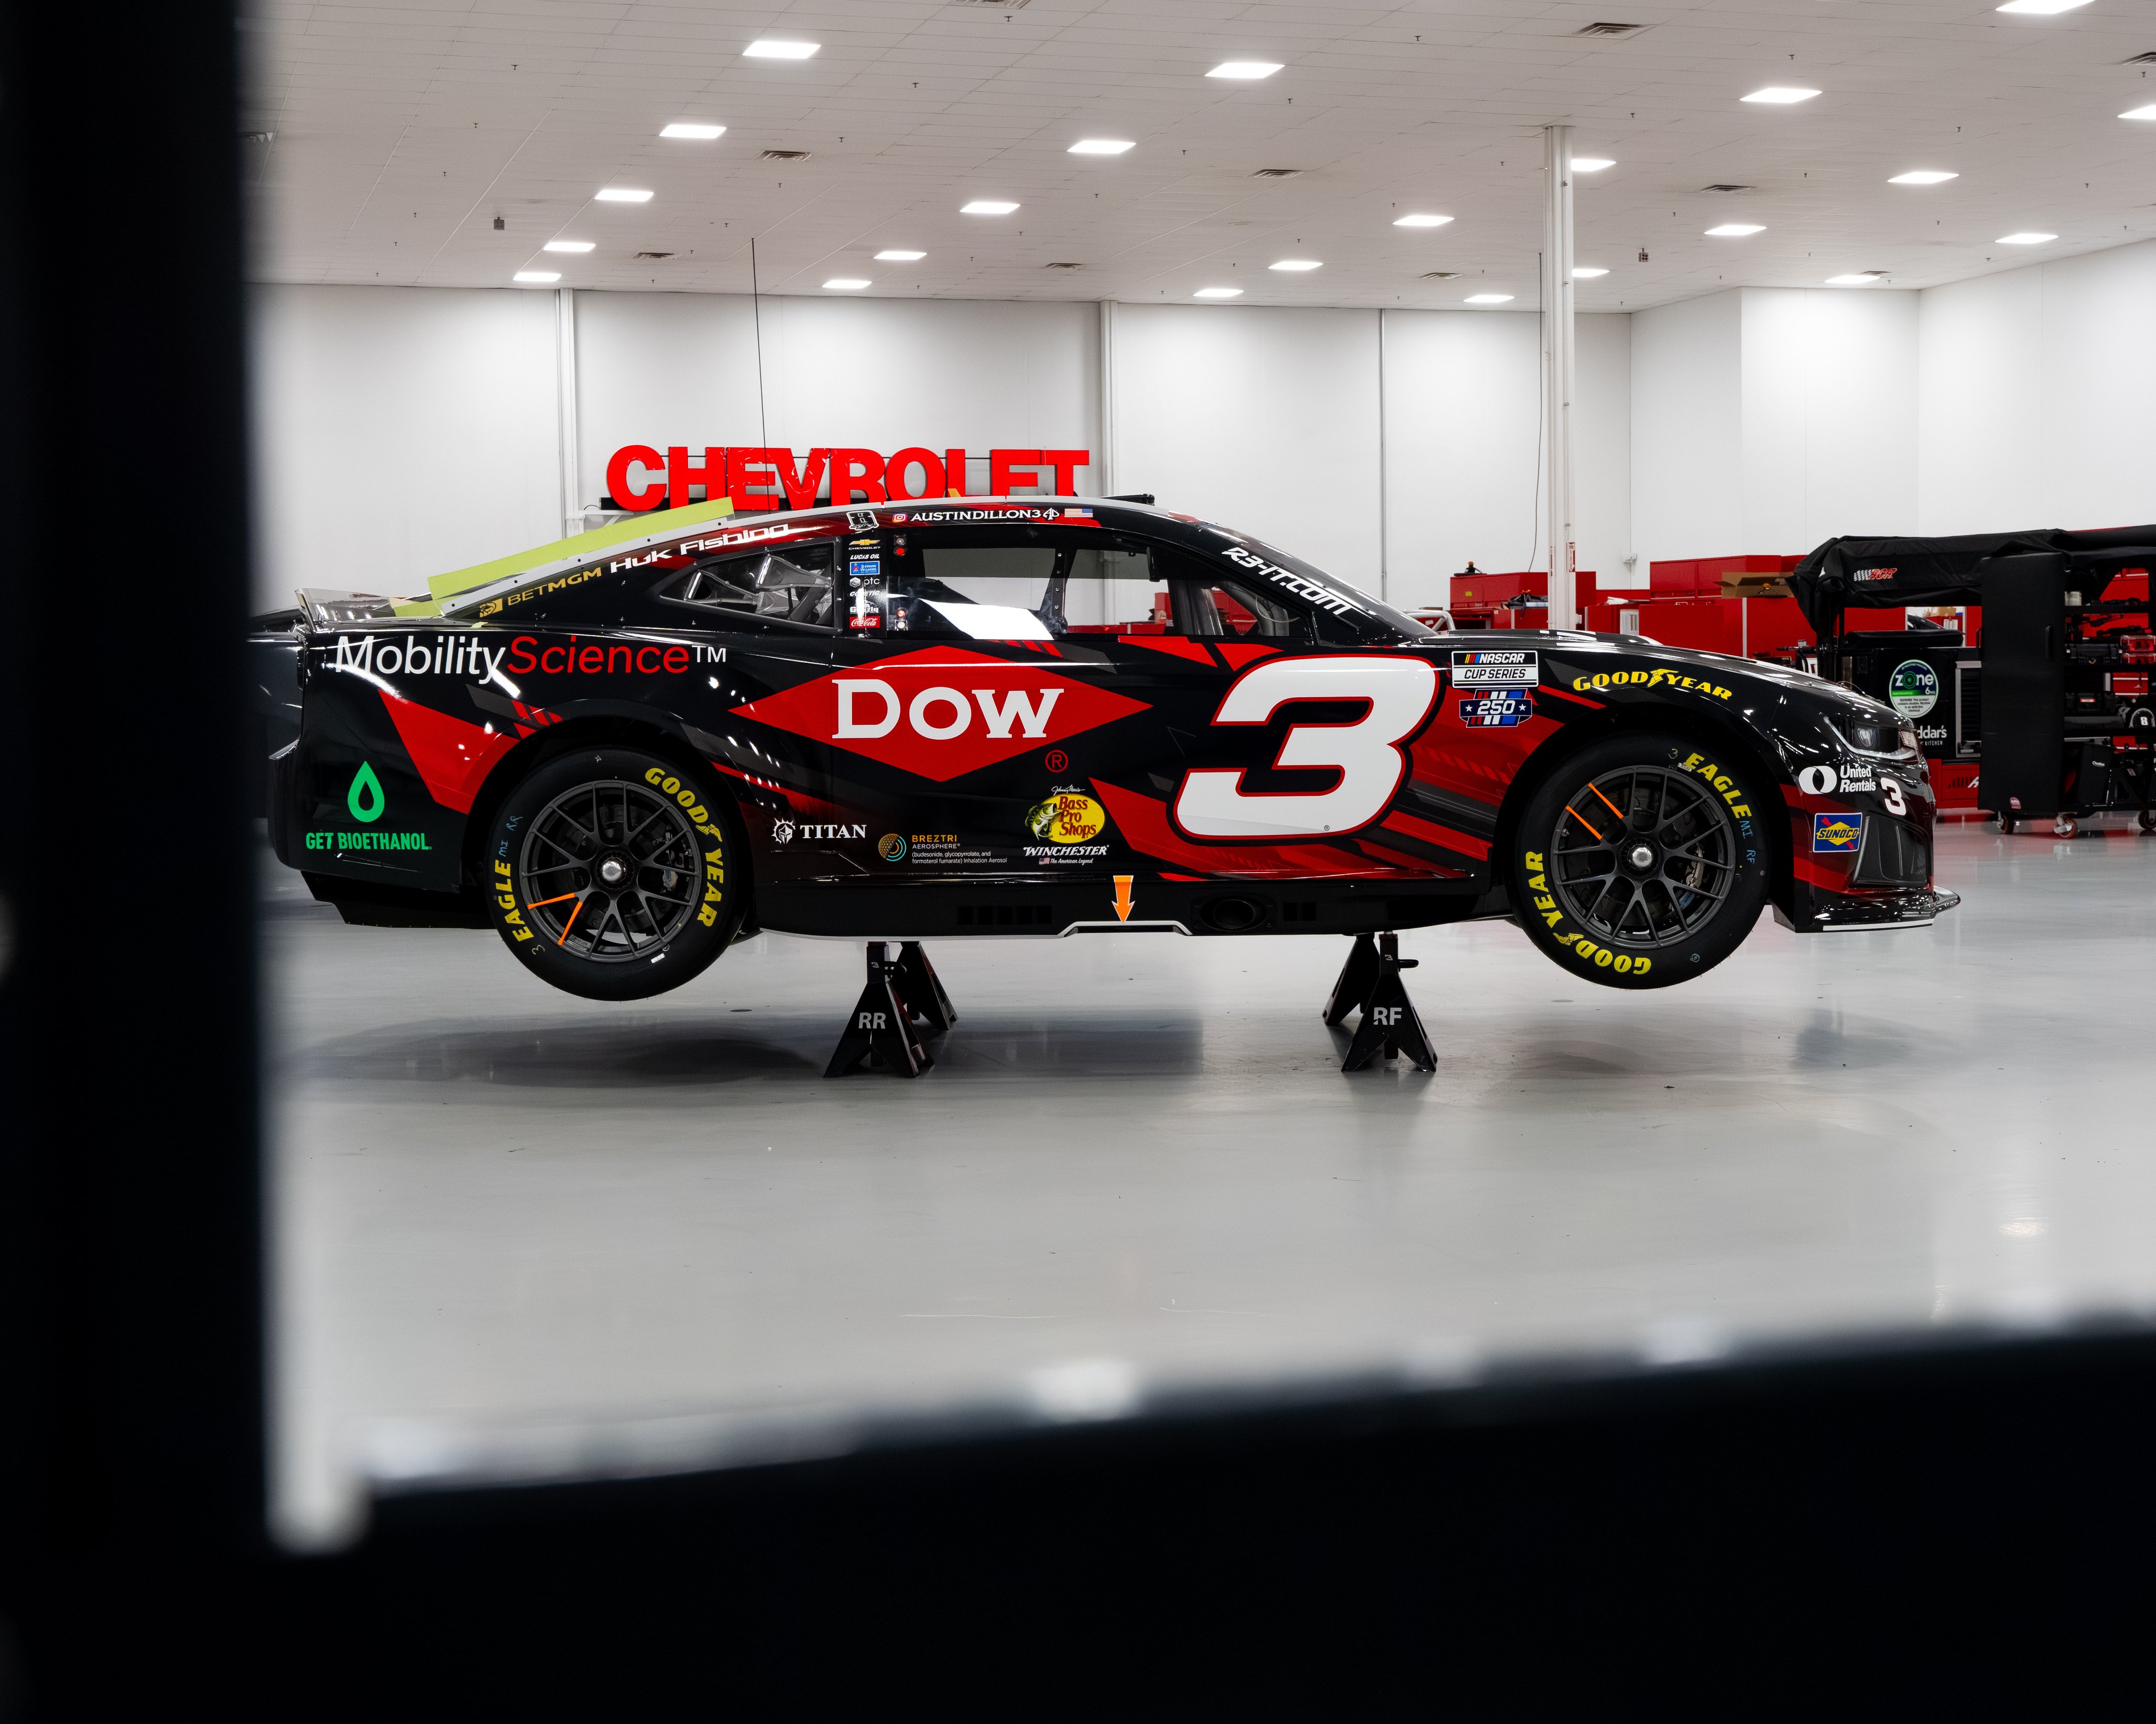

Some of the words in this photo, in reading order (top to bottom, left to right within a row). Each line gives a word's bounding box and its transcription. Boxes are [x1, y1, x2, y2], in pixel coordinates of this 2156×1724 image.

[607, 445, 1089, 510] CHEVROLET
[911, 509, 1041, 522] AUSTINDILLON3
[507, 567, 602, 606] BETMGM
[1479, 654, 1525, 664] NASCAR
[1464, 669, 1486, 679] CUP
[1488, 669, 1526, 679] SERIES
[1477, 700, 1515, 715] 250
[2140, 717, 2148, 725] 8
[1917, 725, 1947, 738] ddar's
[1173, 653, 1440, 840] 3
[1668, 748, 1678, 759] 3
[1840, 765, 1872, 778] United
[1685, 753, 1752, 818] EAGLE
[1840, 778, 1876, 793] Rentals
[1057, 796, 1088, 810] Bass
[1880, 777, 1907, 816] 3
[1059, 809, 1082, 823] Pro
[800, 825, 867, 838] TITAN
[1060, 822, 1096, 838] Shops
[1818, 829, 1859, 838] SUNOCO
[306, 833, 334, 849] GET
[1746, 850, 1756, 864] RF
[495, 860, 534, 942] EAGLE
[859, 1012, 885, 1029] RR
[1373, 1007, 1402, 1025] RF
